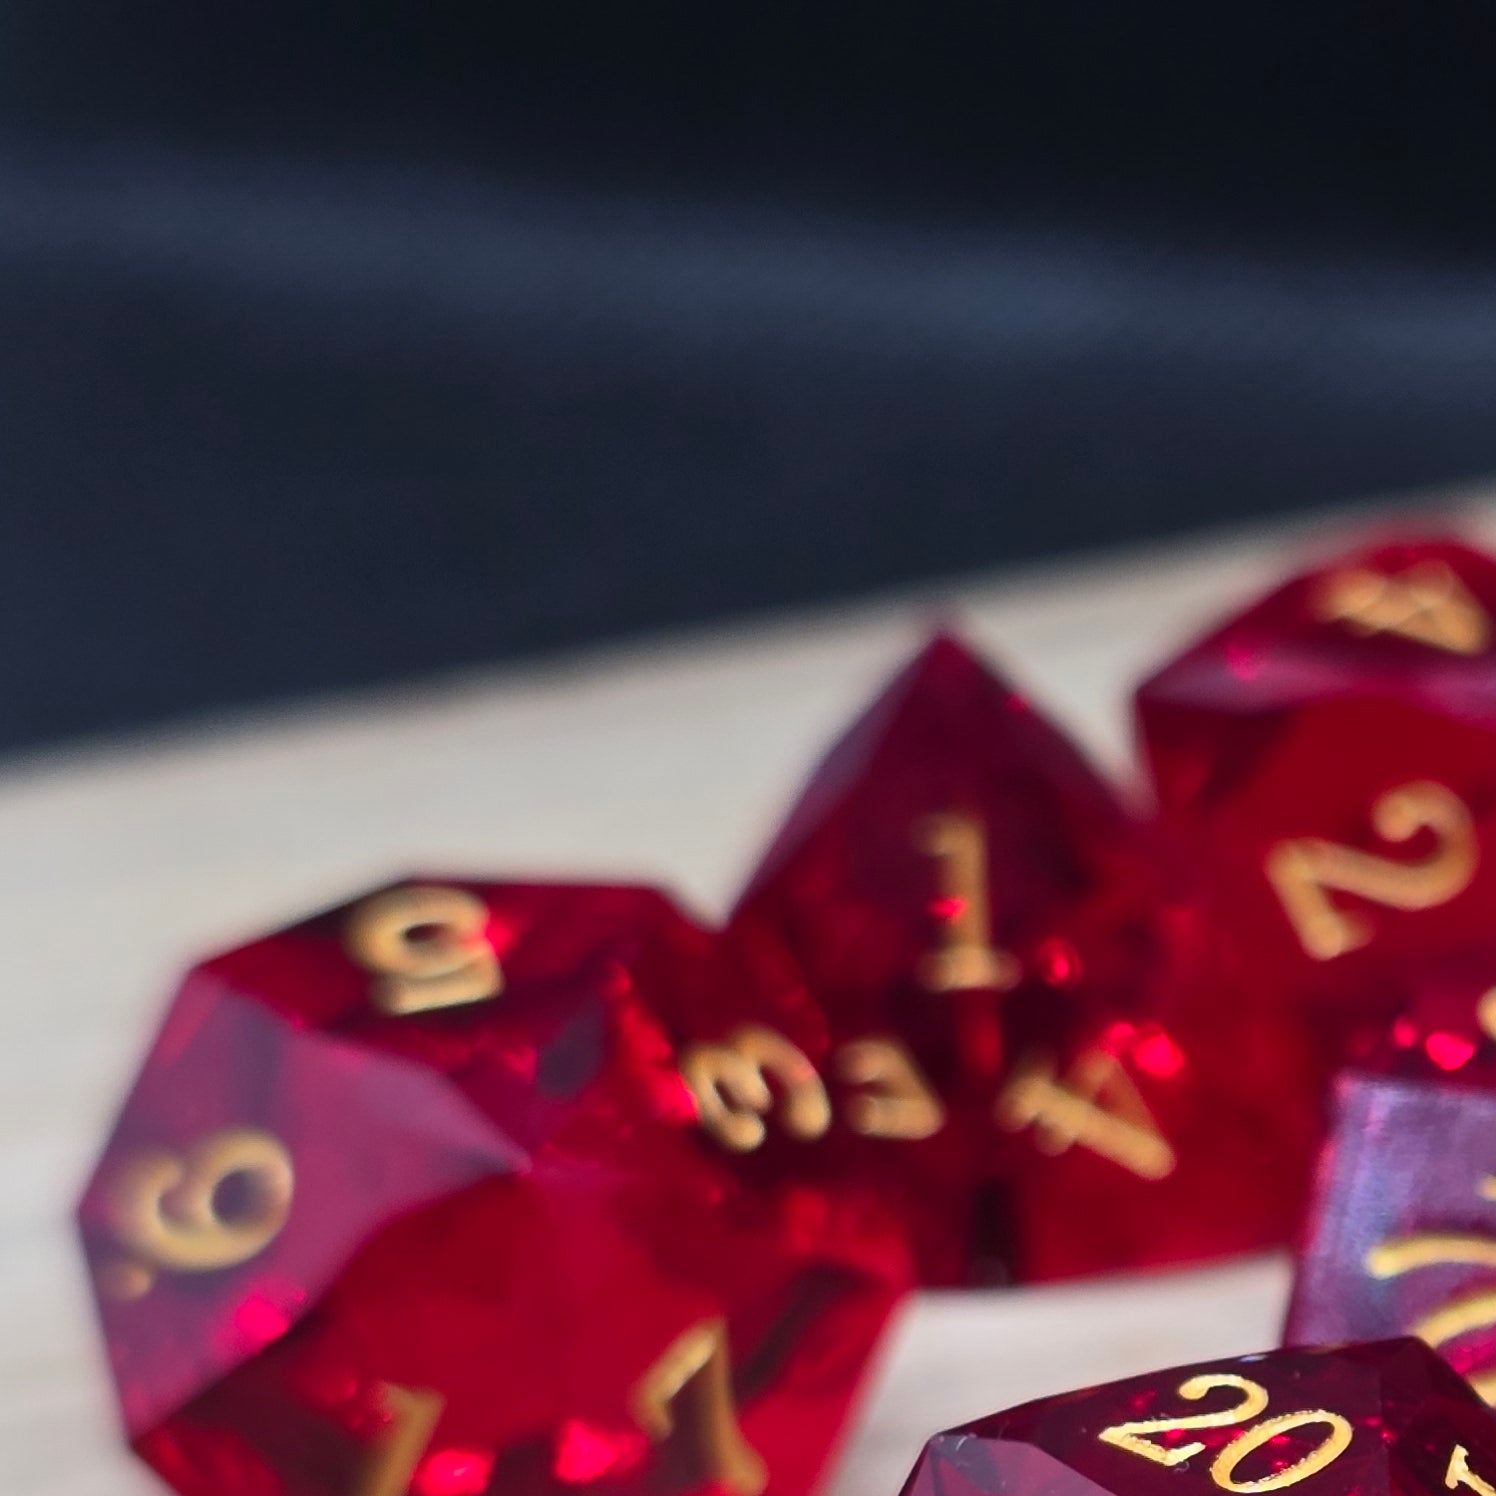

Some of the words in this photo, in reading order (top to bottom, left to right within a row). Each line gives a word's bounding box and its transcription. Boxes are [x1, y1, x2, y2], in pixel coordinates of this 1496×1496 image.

[912, 810, 1022, 992] 1
[1265, 779, 1480, 961] 2
[348, 886, 503, 1015] 5
[683, 1022, 832, 1152] 3
[997, 1044, 1177, 1181] 4
[1100, 1374, 1353, 1493] 20
